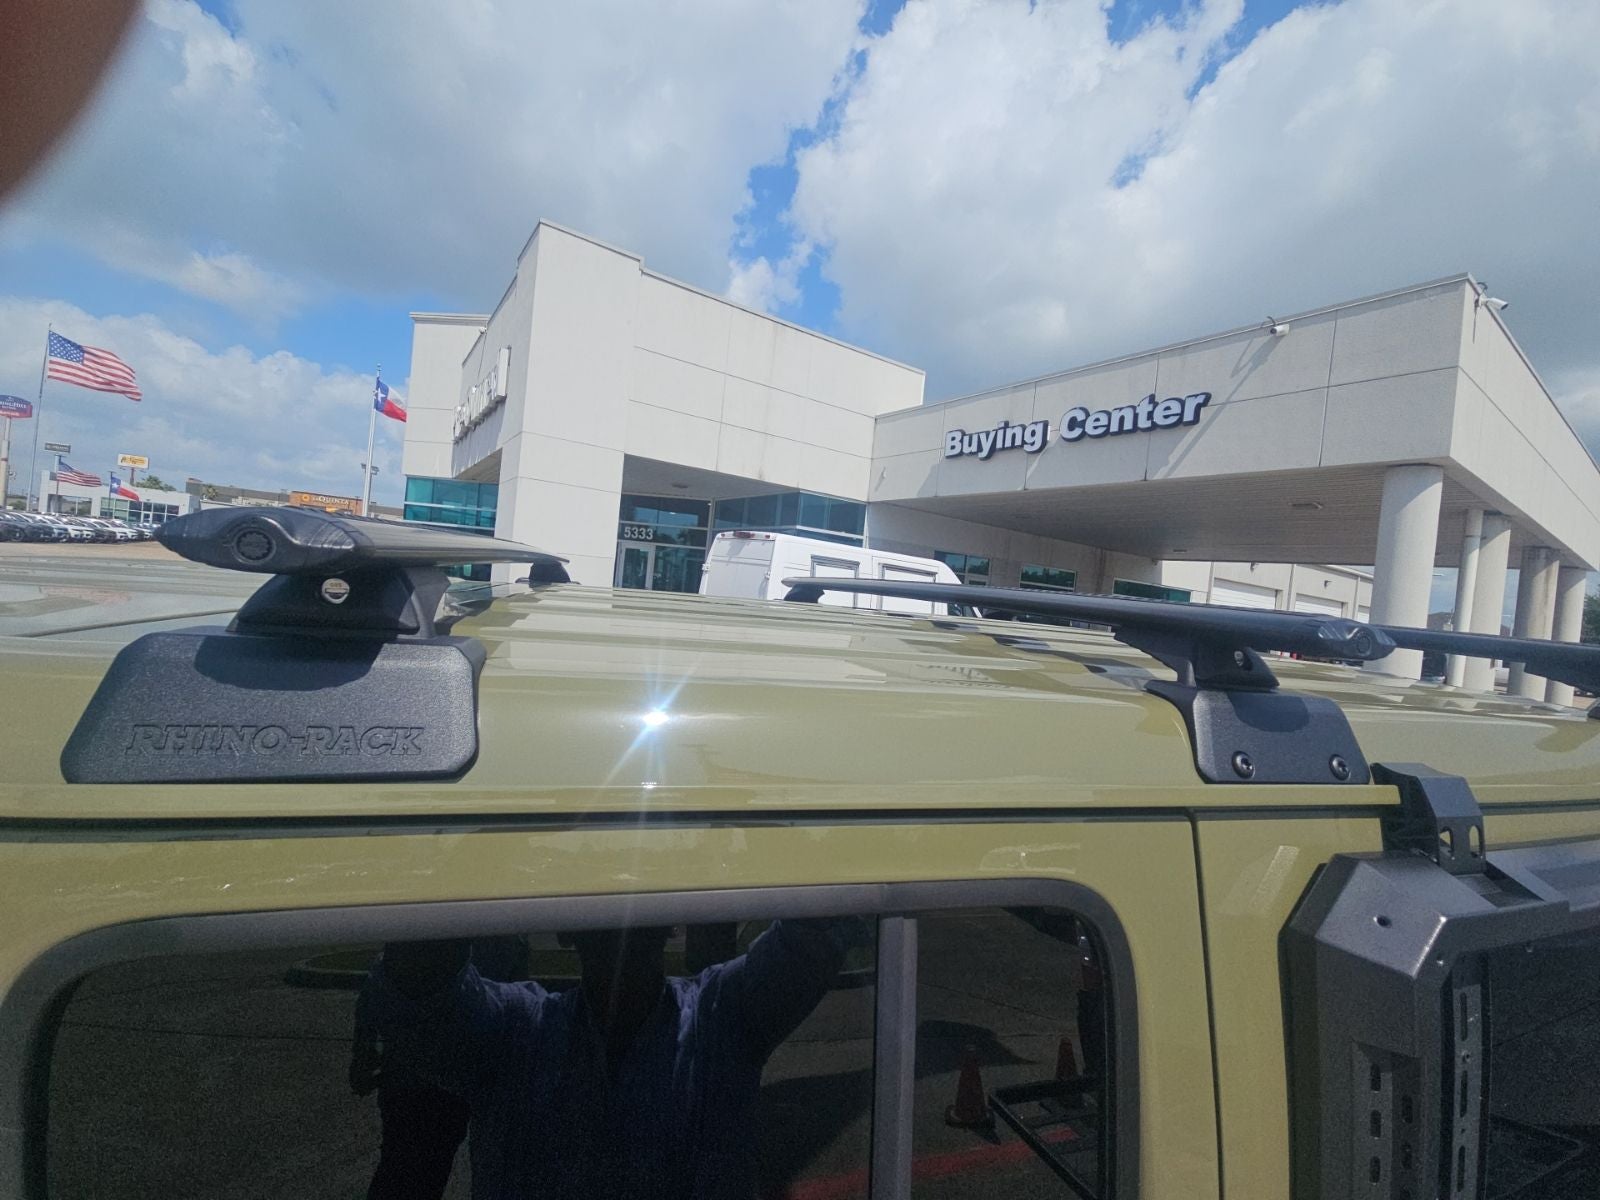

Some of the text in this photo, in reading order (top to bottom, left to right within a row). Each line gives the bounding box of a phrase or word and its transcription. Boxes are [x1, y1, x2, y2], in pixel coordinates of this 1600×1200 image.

[945, 392, 1212, 461] Buying Center
[624, 526, 654, 540] 5333
[125, 723, 424, 756] RHINO-RACK
